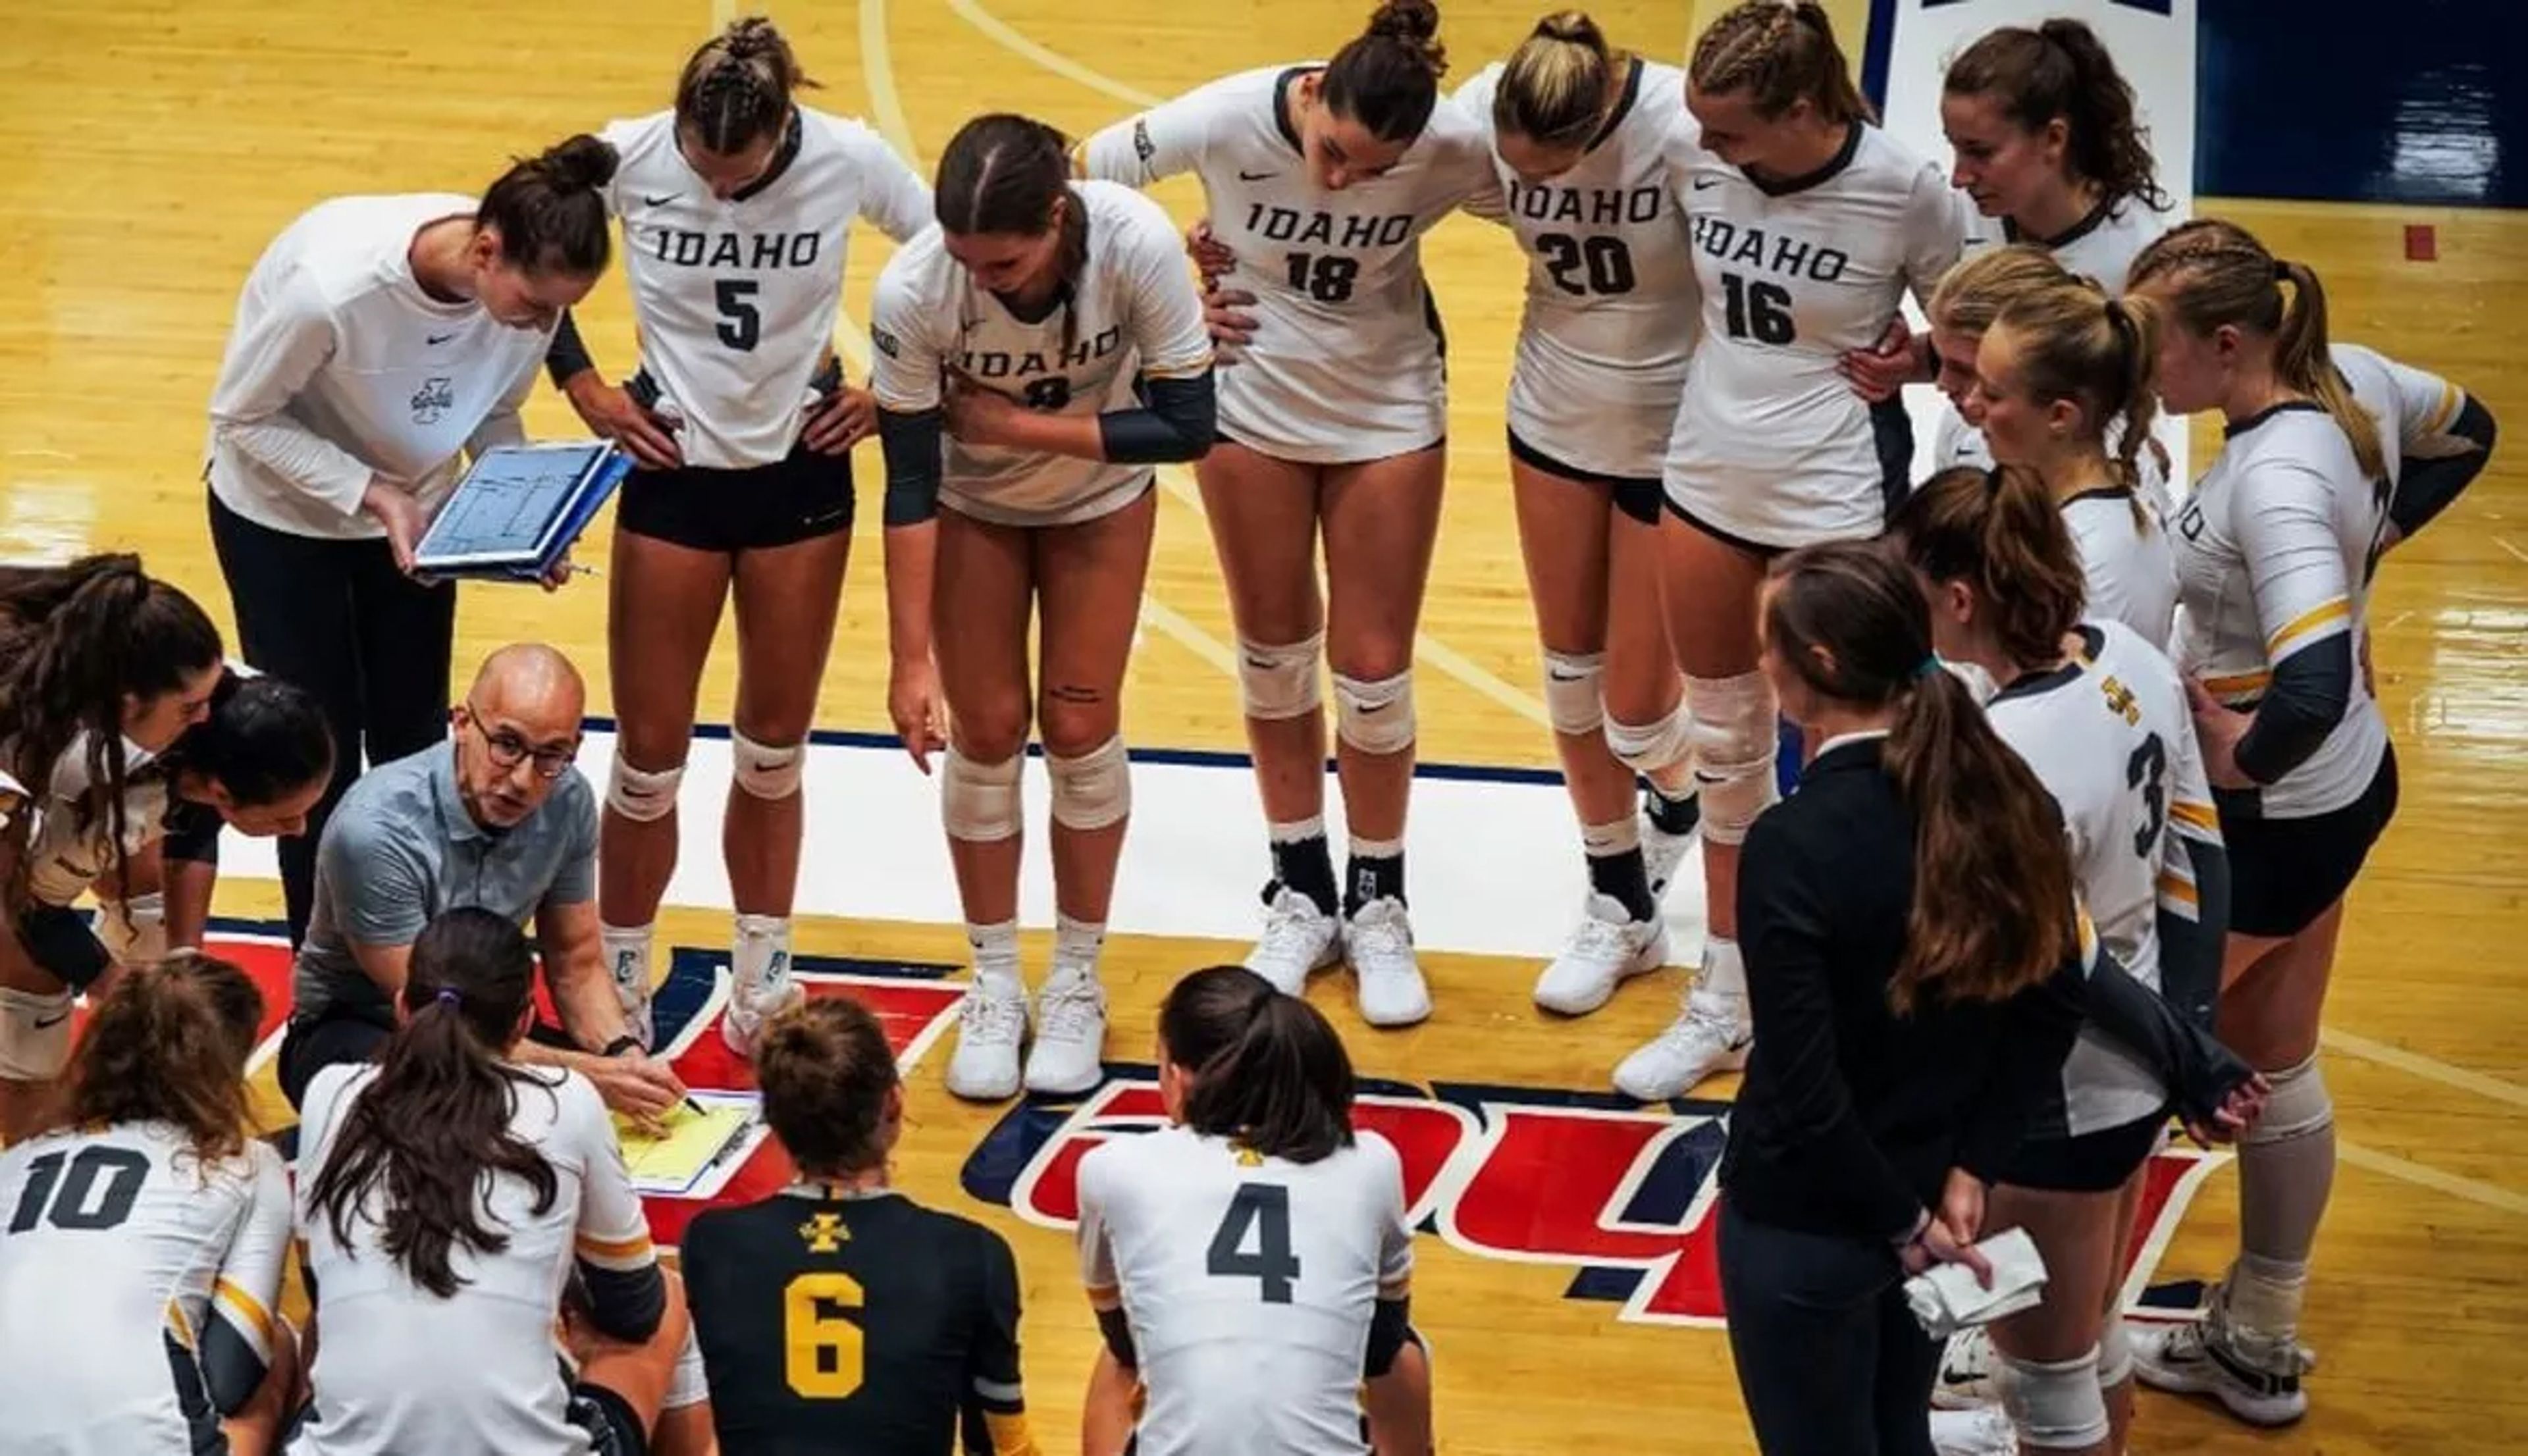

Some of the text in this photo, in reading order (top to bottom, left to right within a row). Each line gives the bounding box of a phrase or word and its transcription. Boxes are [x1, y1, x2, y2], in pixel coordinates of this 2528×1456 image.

[1246, 203, 1414, 247] IDAHO
[1510, 179, 1661, 224] IDAHO
[656, 230, 821, 269] IDAHO
[1285, 251, 1359, 302] 18
[1536, 232, 1637, 296] 20
[1695, 216, 1848, 282] IDAHO
[715, 279, 760, 353] 5
[1721, 272, 1796, 345] 16
[962, 324, 1119, 377] IDAHO
[2126, 731, 2167, 859] 3
[9, 1144, 151, 1235] 10
[1206, 1182, 1301, 1305] 4
[784, 1272, 864, 1399] 6
